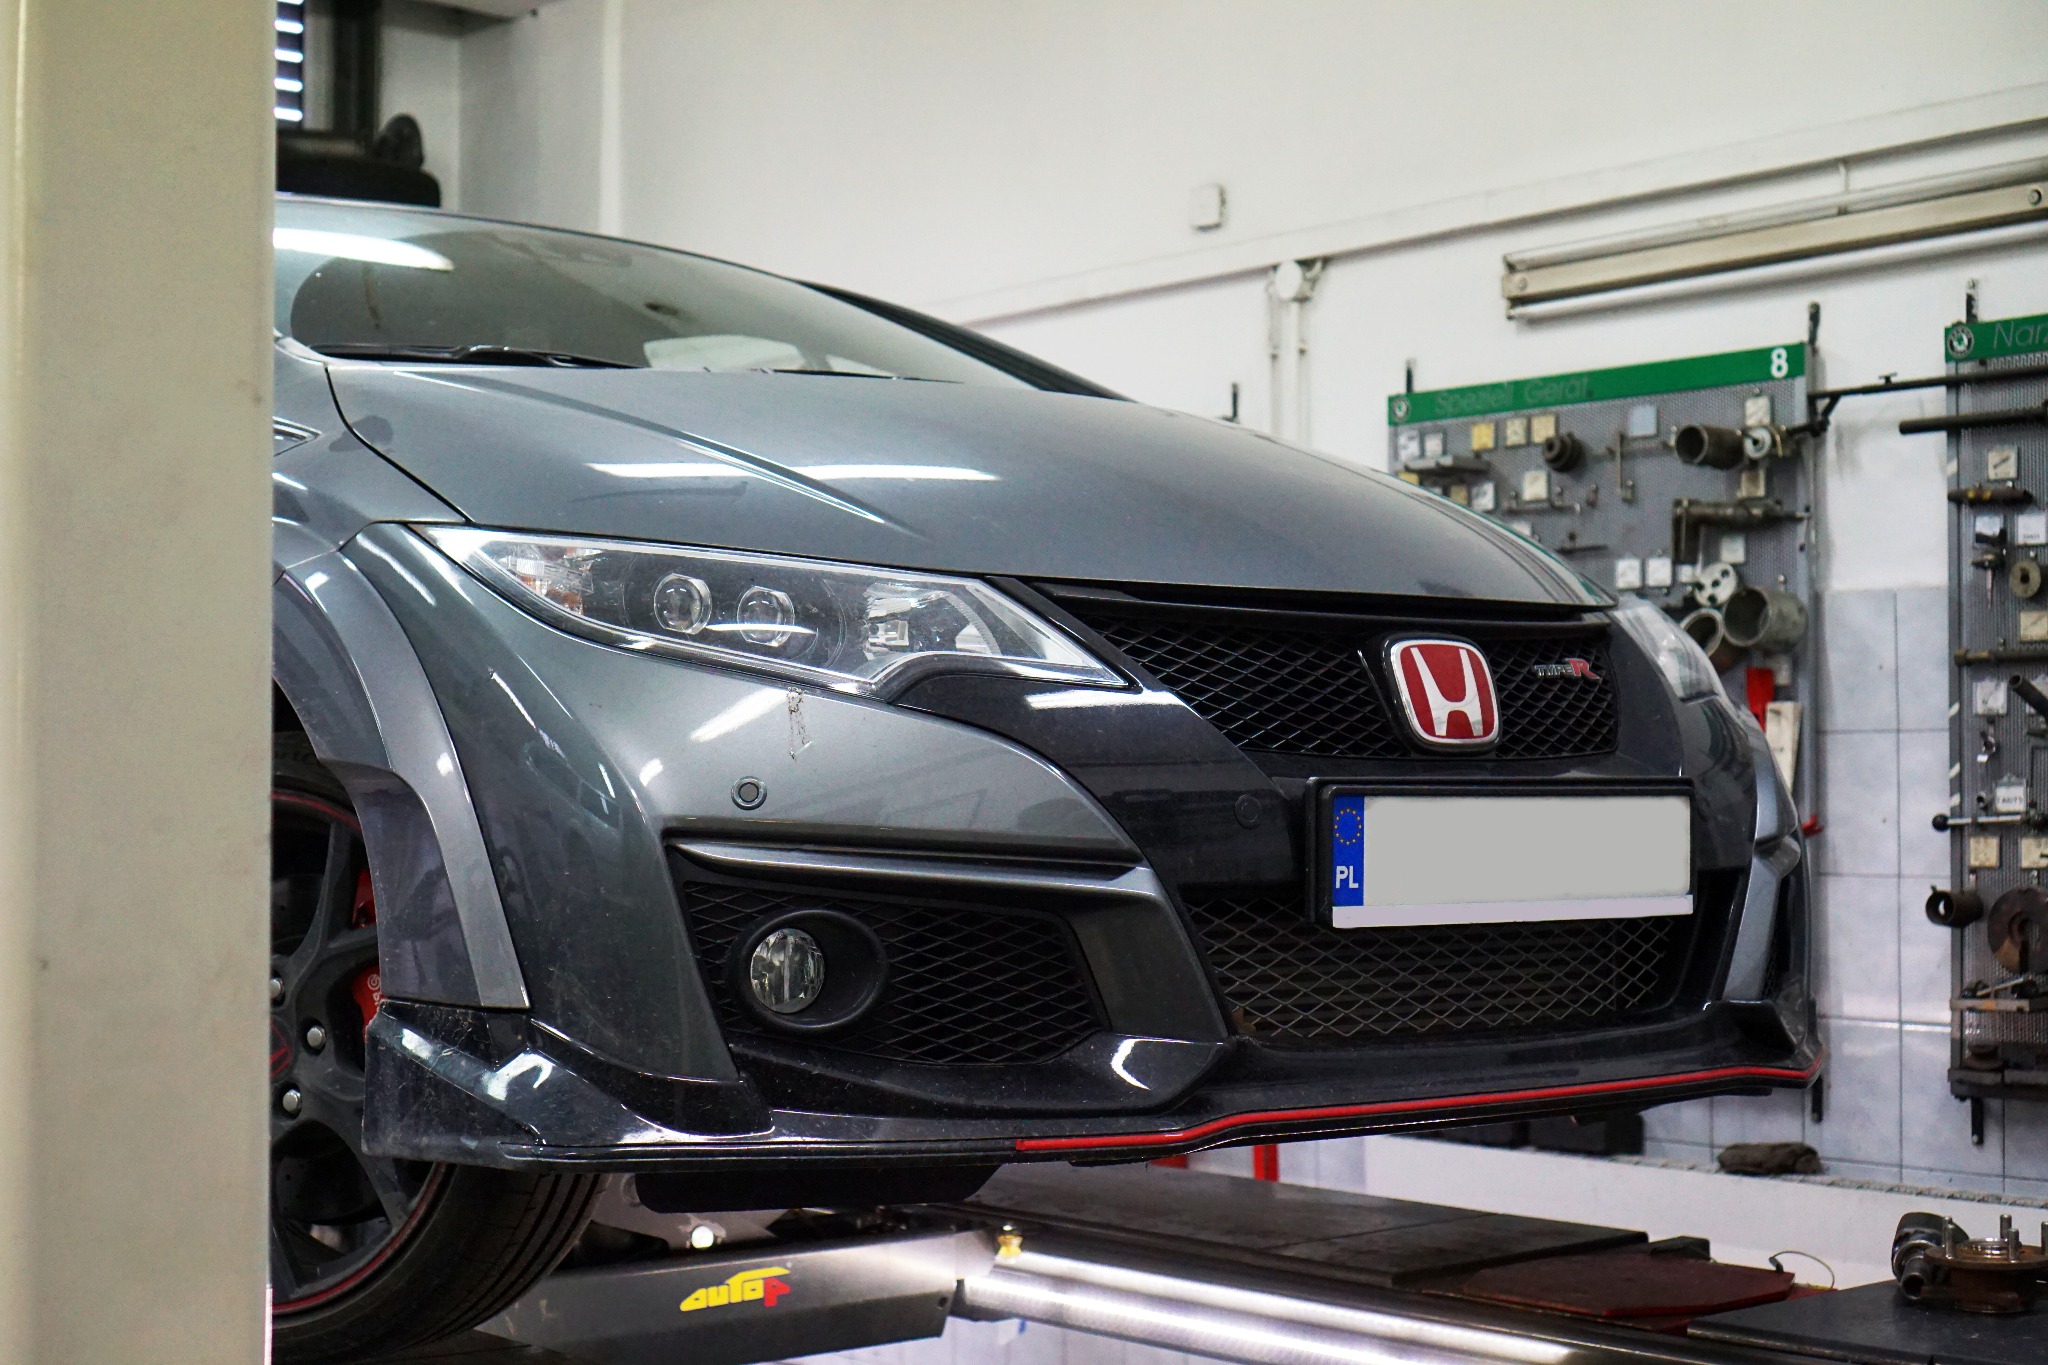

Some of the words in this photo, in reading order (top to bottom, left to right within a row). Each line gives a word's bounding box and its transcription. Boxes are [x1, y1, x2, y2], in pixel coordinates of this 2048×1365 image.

[1771, 347, 1788, 379] 8
[1563, 658, 1601, 679] R
[1335, 865, 1359, 889] PL
